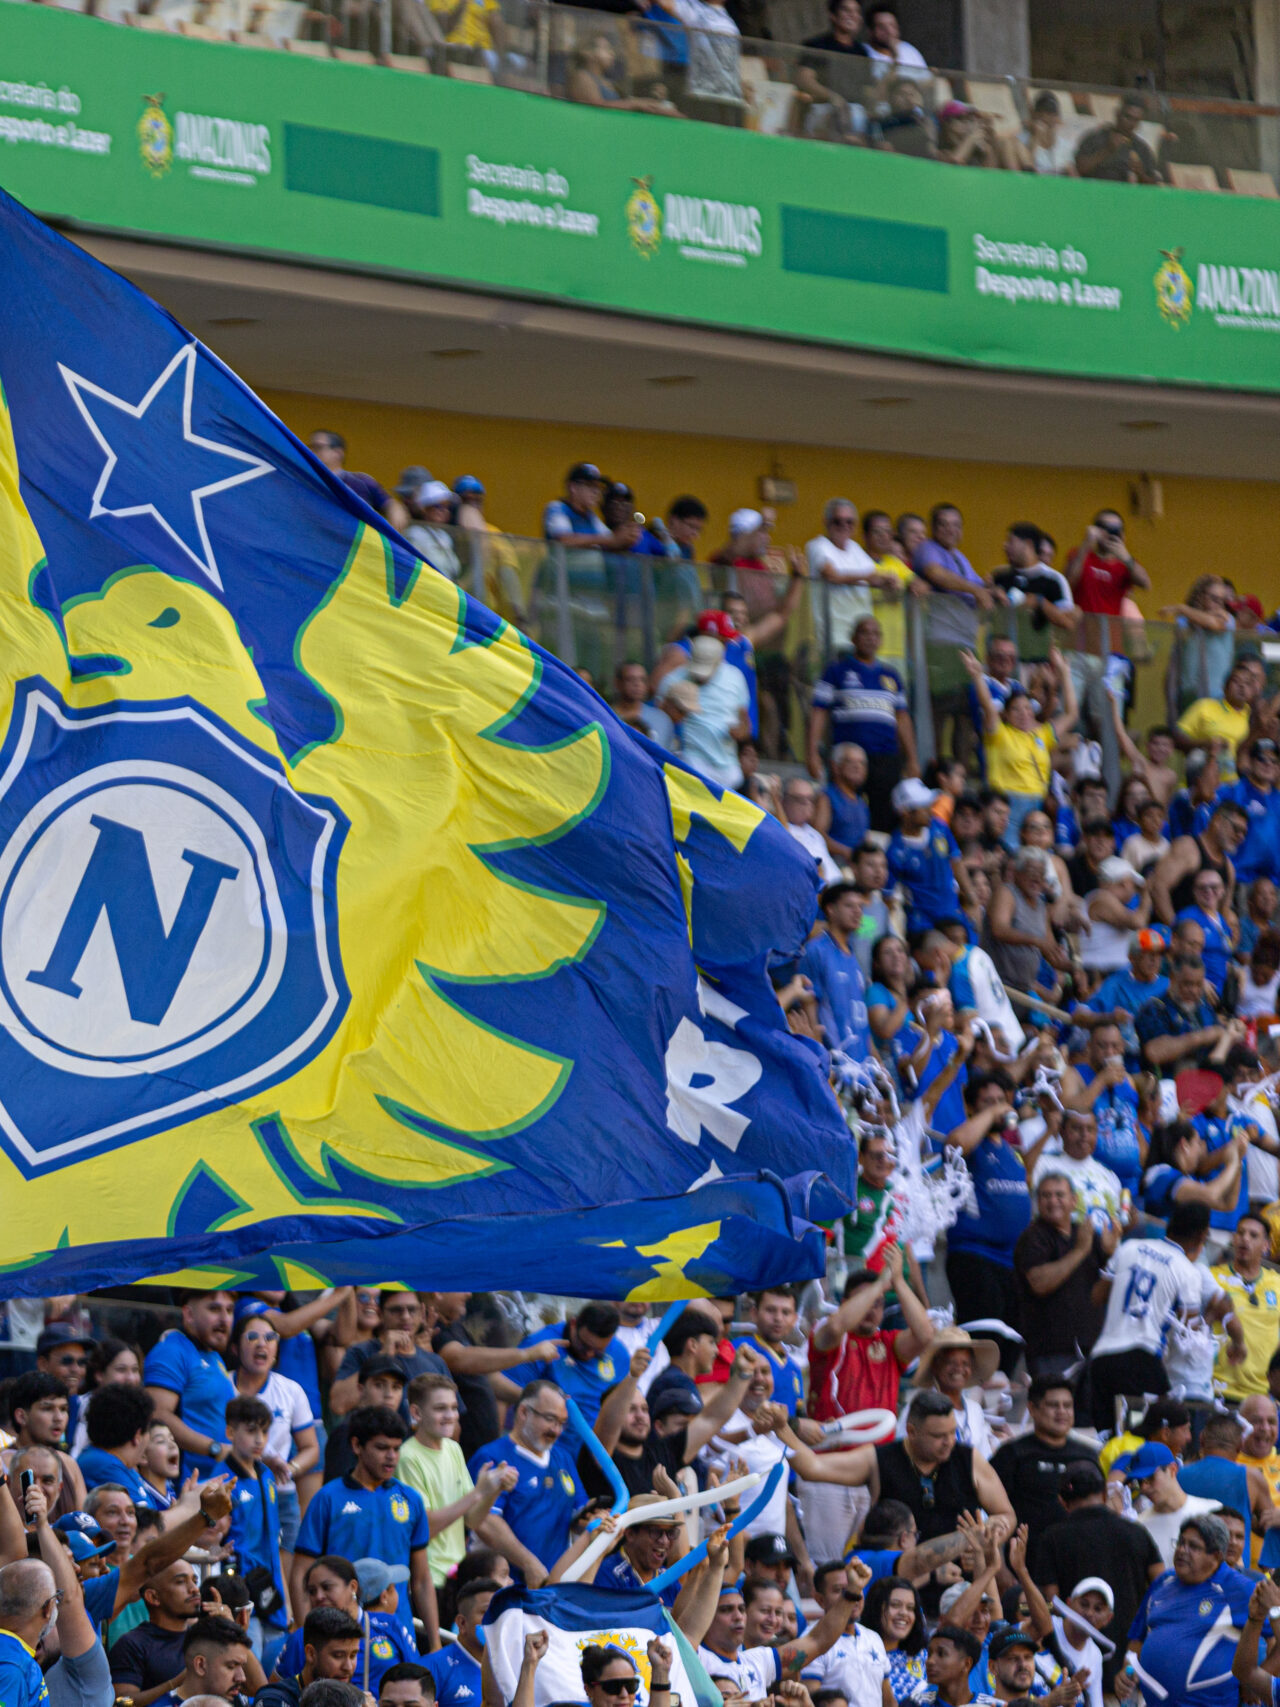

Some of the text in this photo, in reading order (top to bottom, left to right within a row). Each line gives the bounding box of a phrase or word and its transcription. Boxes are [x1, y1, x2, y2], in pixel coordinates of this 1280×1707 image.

[174, 110, 271, 175] AMAZONAS
[664, 192, 762, 257] AMAZONAS
[1197, 262, 1280, 318] AMAZON
[25, 813, 240, 1027] N
